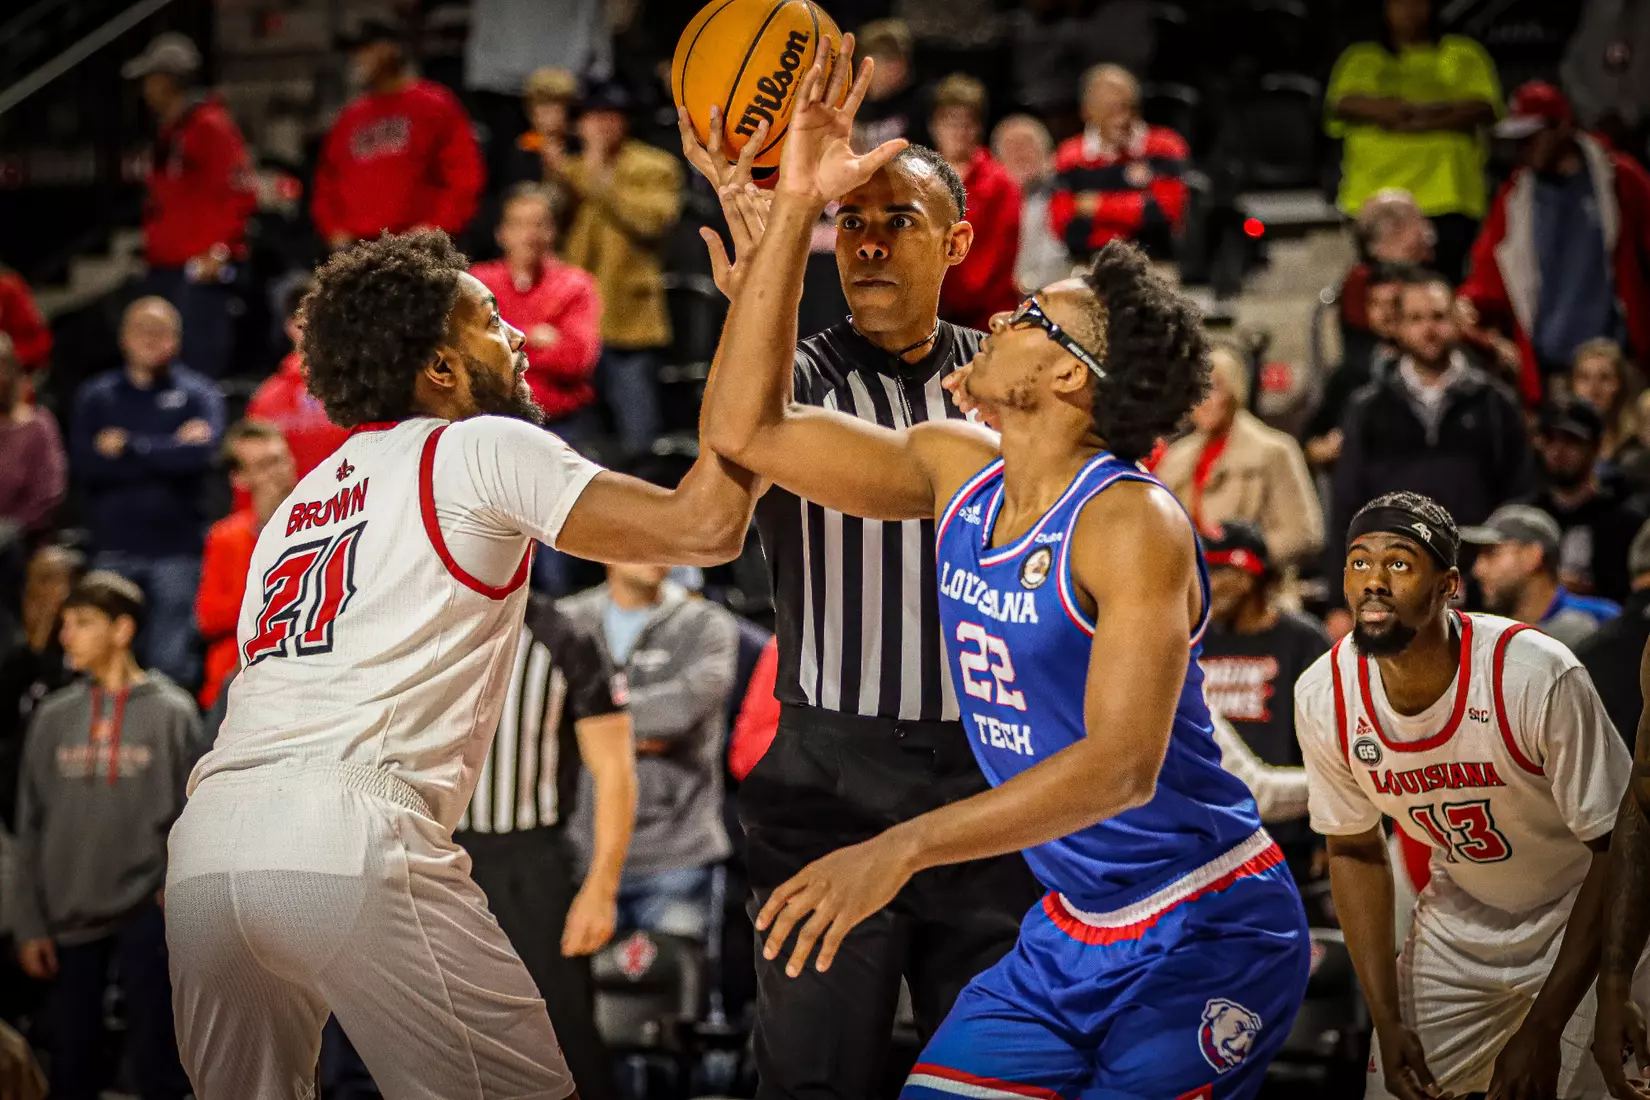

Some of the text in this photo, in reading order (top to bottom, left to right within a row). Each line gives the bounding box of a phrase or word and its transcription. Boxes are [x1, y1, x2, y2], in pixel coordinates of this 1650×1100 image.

[734, 30, 810, 137] Wilson
[285, 477, 370, 538] BROWN
[243, 520, 369, 667] 21
[956, 620, 1028, 712] 22
[972, 712, 1035, 756] TECH
[1368, 762, 1508, 796] LOUISIANA
[1408, 798, 1513, 864] 13
